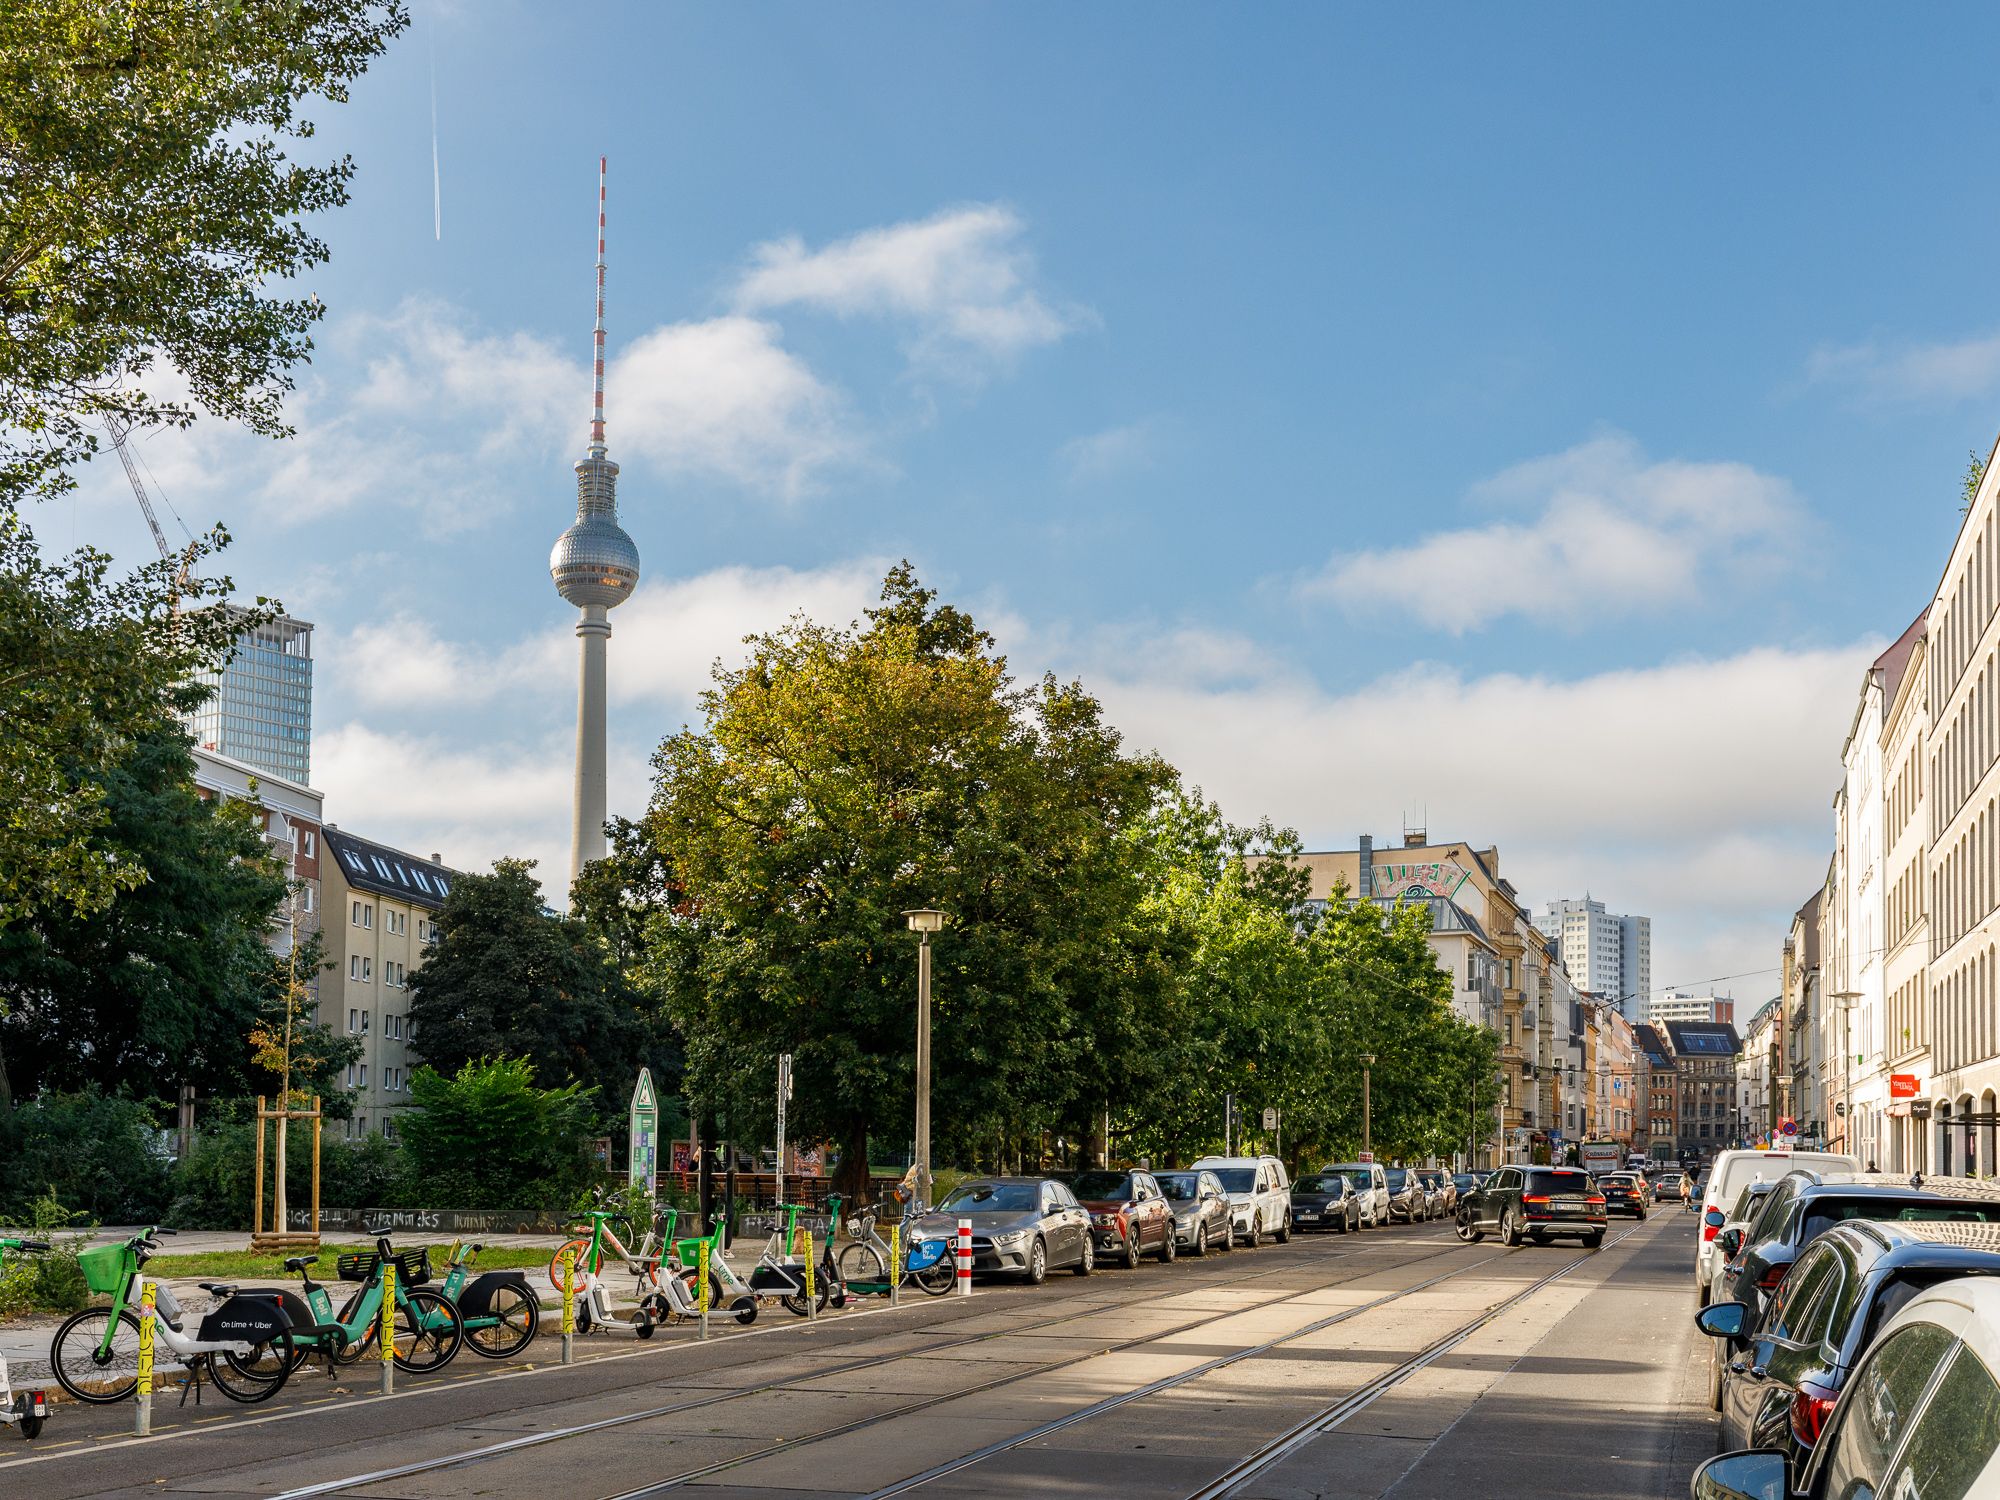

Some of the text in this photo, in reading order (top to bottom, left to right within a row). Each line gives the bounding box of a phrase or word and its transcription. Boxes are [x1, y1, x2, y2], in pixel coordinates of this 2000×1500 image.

[718, 1264, 734, 1286] Lime
[315, 1296, 329, 1316] Bolt
[231, 1321, 247, 1329] Lime
[254, 1321, 272, 1329] Uber
